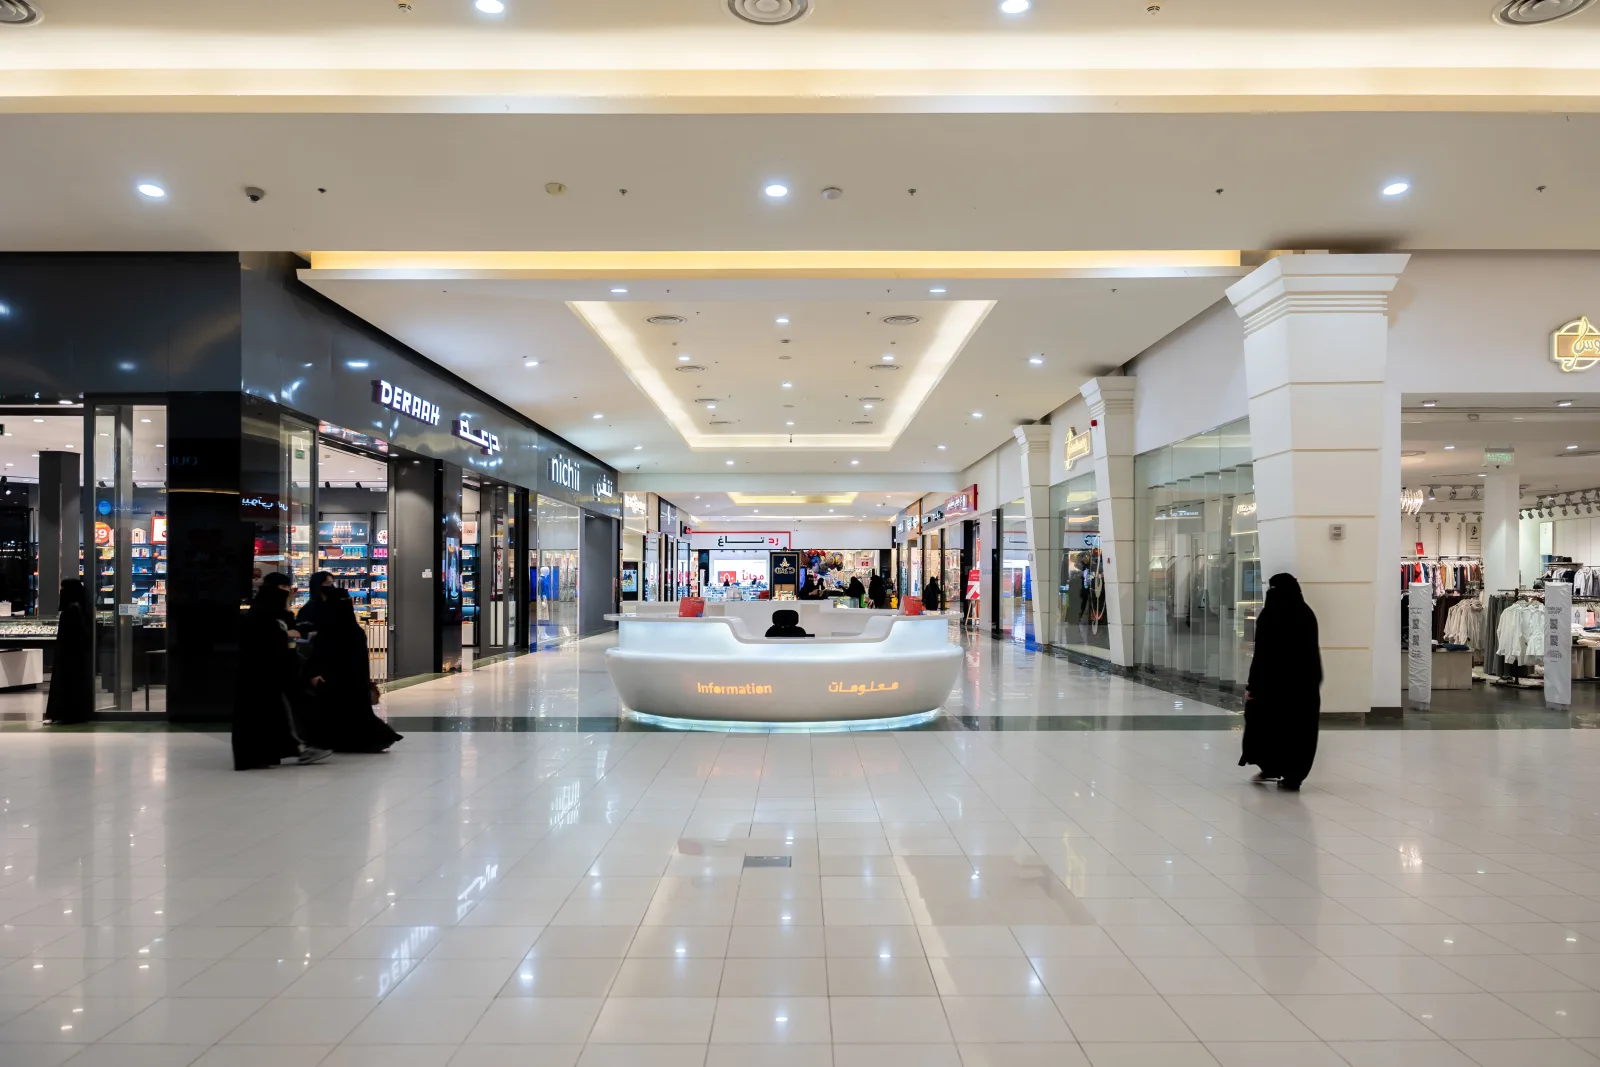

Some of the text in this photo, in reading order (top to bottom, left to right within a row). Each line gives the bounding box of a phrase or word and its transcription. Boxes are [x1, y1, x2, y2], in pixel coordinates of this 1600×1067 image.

[379, 380, 440, 425] DERAAH
[551, 453, 580, 492] nichii
[768, 538, 779, 546] رد
[698, 682, 772, 695] Information
[828, 681, 899, 696] معلومات
